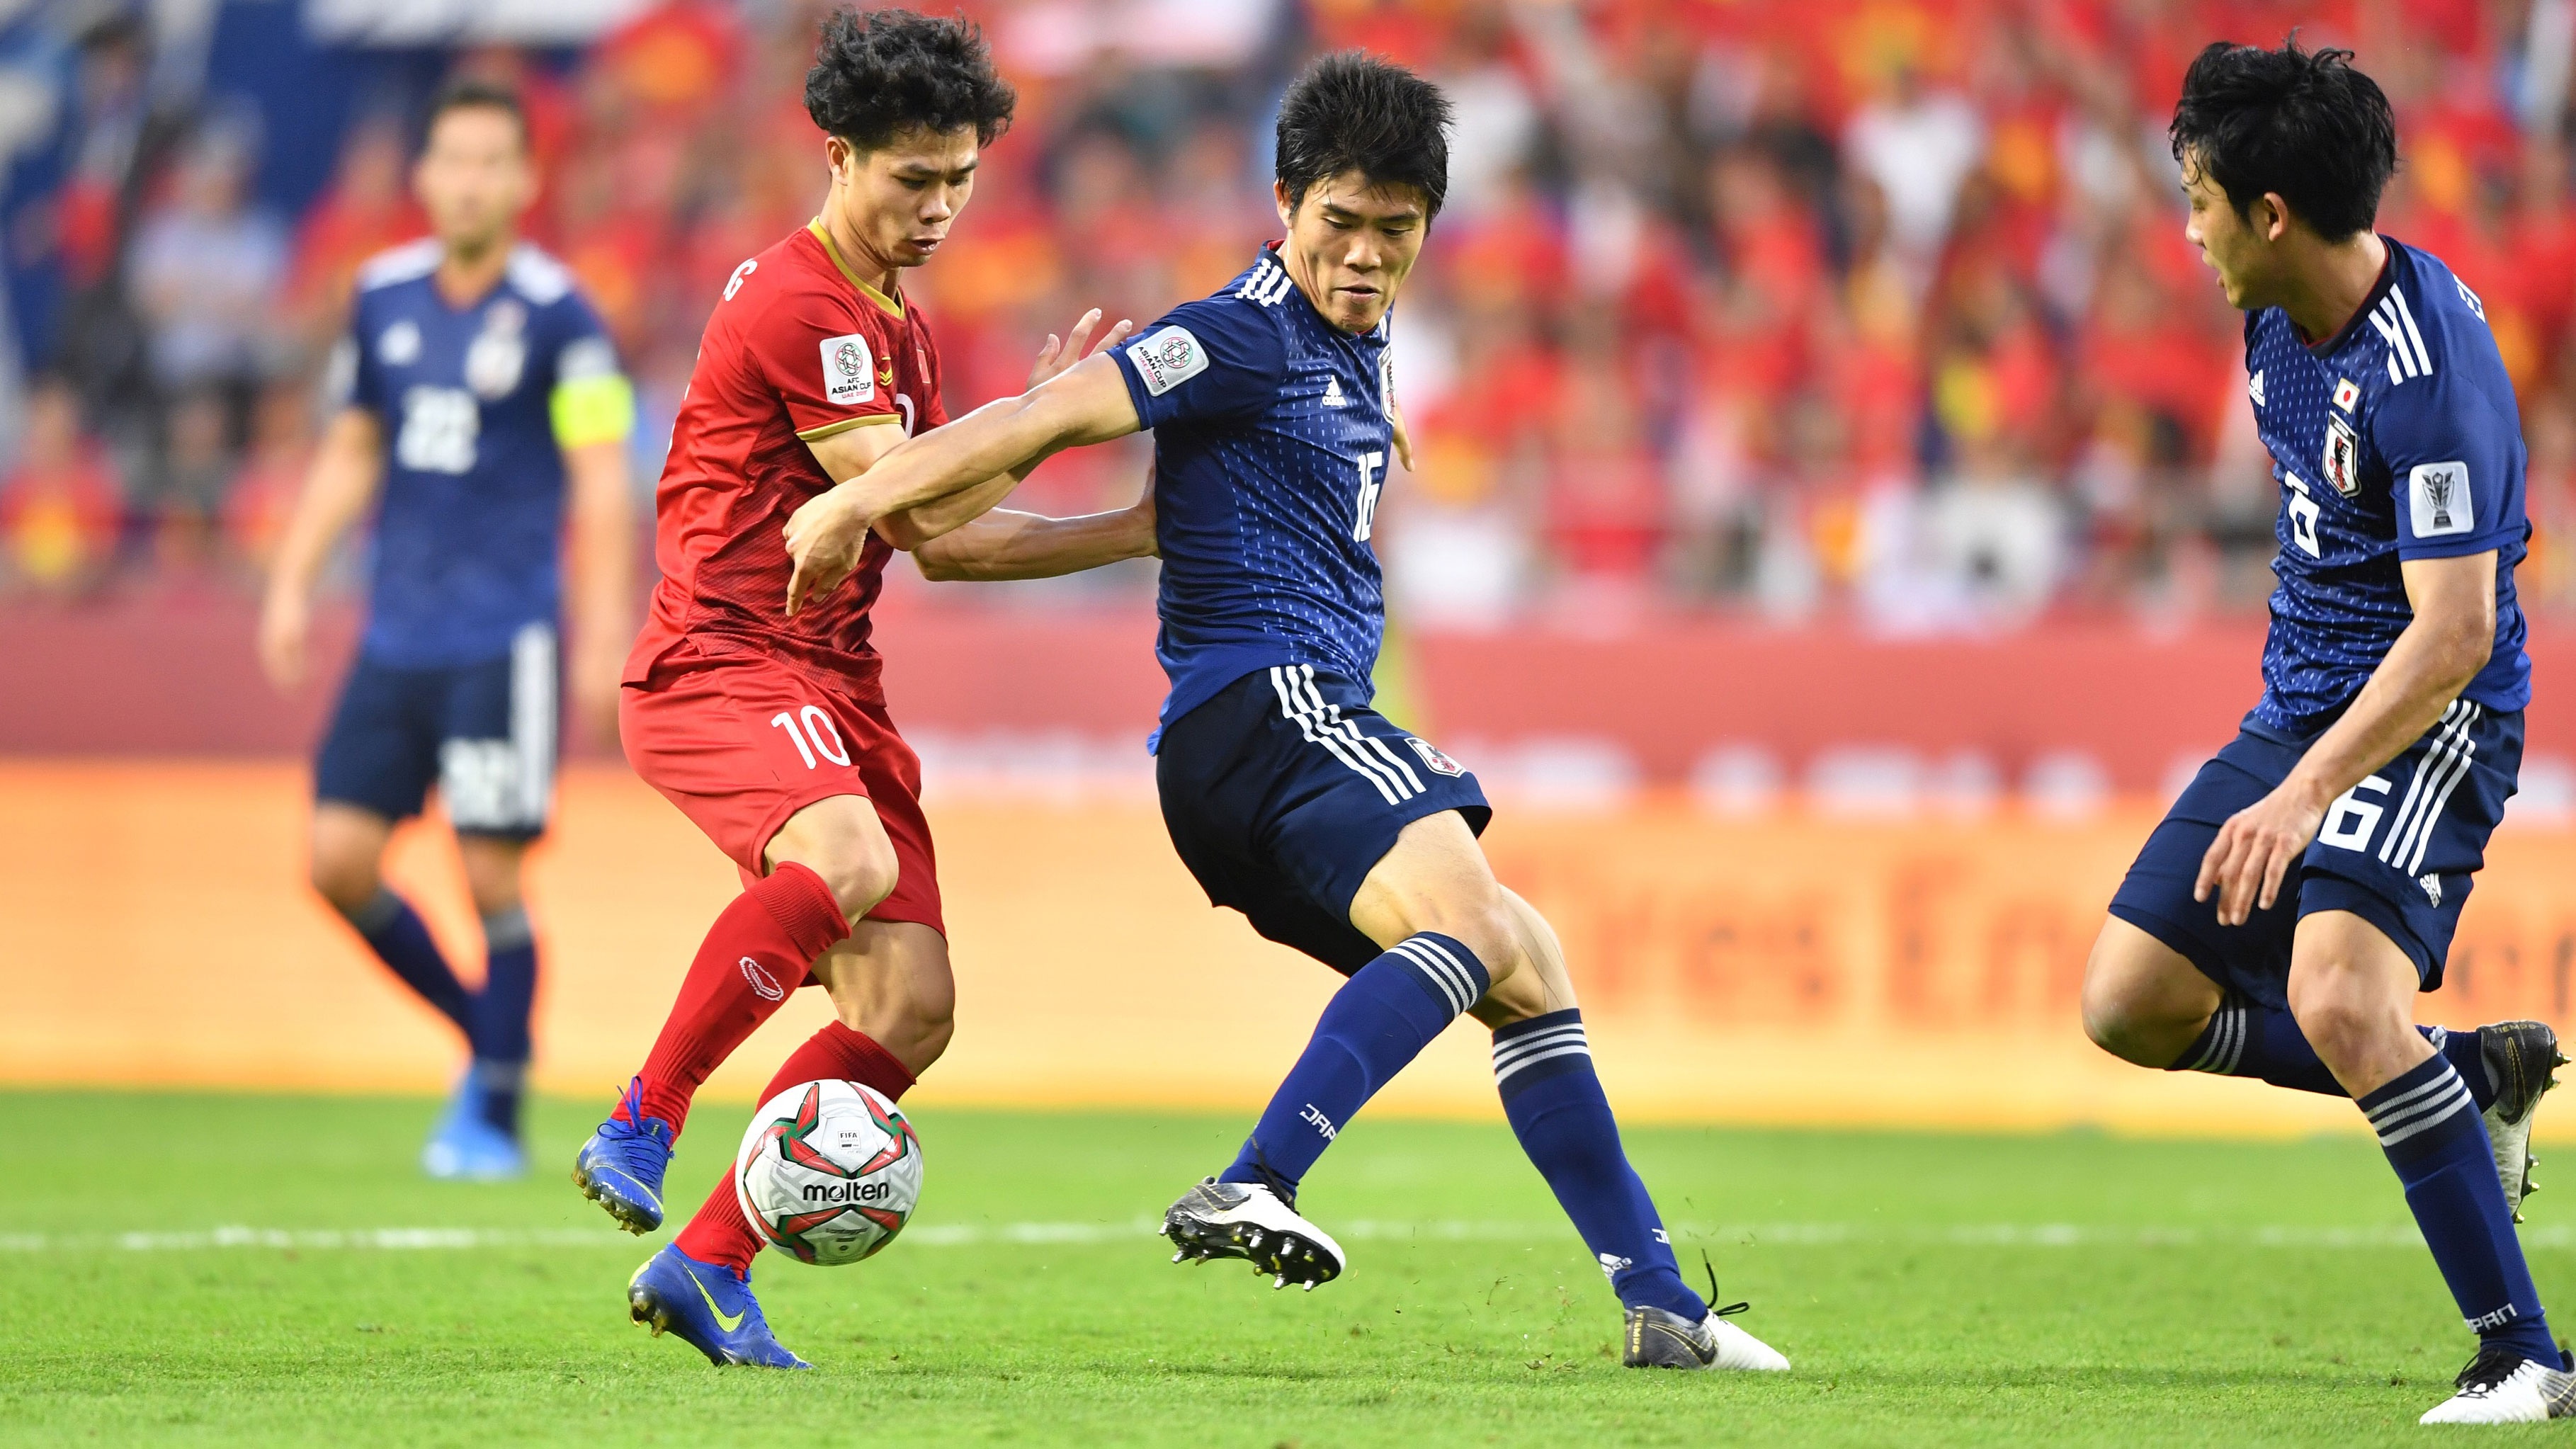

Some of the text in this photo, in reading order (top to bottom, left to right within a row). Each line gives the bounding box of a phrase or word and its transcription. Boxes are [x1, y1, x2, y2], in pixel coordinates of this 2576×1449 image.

[1137, 356, 1147, 368] UAE
[1137, 346, 1167, 388] ASIAN CUP
[1153, 356, 1164, 370] AFC
[832, 384, 858, 394] ASIAN
[1354, 451, 1383, 542] 16
[2285, 470, 2320, 559] 6
[771, 705, 851, 770] 10
[2317, 775, 2392, 853] 6
[2490, 1024, 2536, 1034] TIEMPO
[802, 1181, 890, 1202] molten
[1632, 1312, 1644, 1353] TIEMPO
